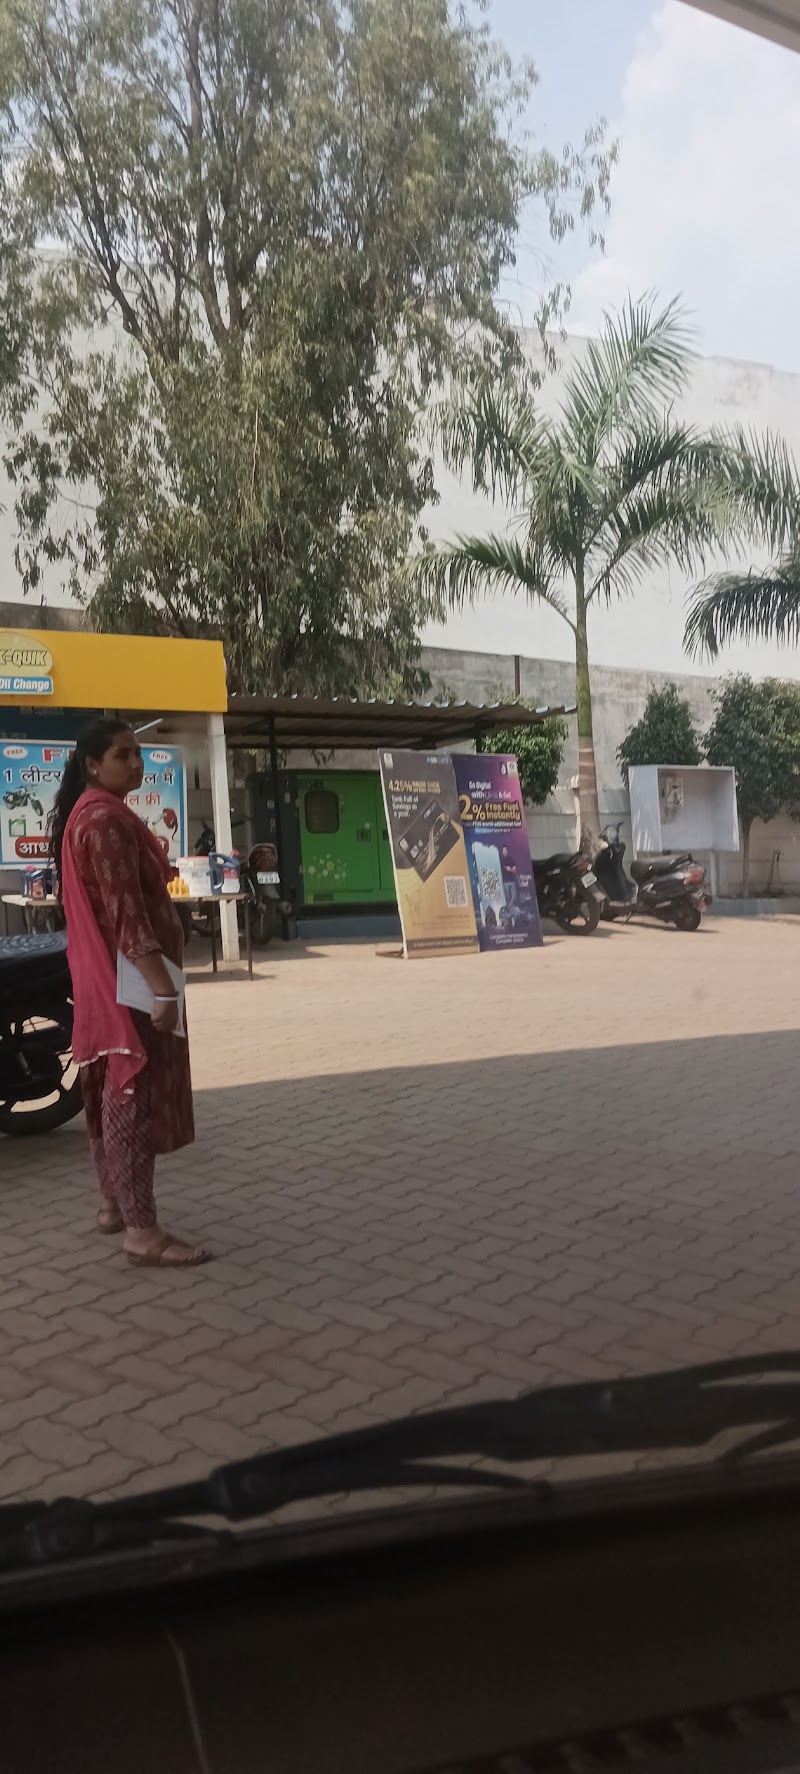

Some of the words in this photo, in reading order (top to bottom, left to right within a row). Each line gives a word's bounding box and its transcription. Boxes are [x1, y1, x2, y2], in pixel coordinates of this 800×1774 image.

[0, 649, 48, 668] K-QUIK
[13, 678, 50, 692] Change
[4, 769, 12, 783] 1
[458, 794, 473, 820] 2
[472, 803, 486, 820] %
[485, 802, 502, 811] Free
[502, 802, 519, 811] Fuel
[486, 810, 520, 821] Instantly
